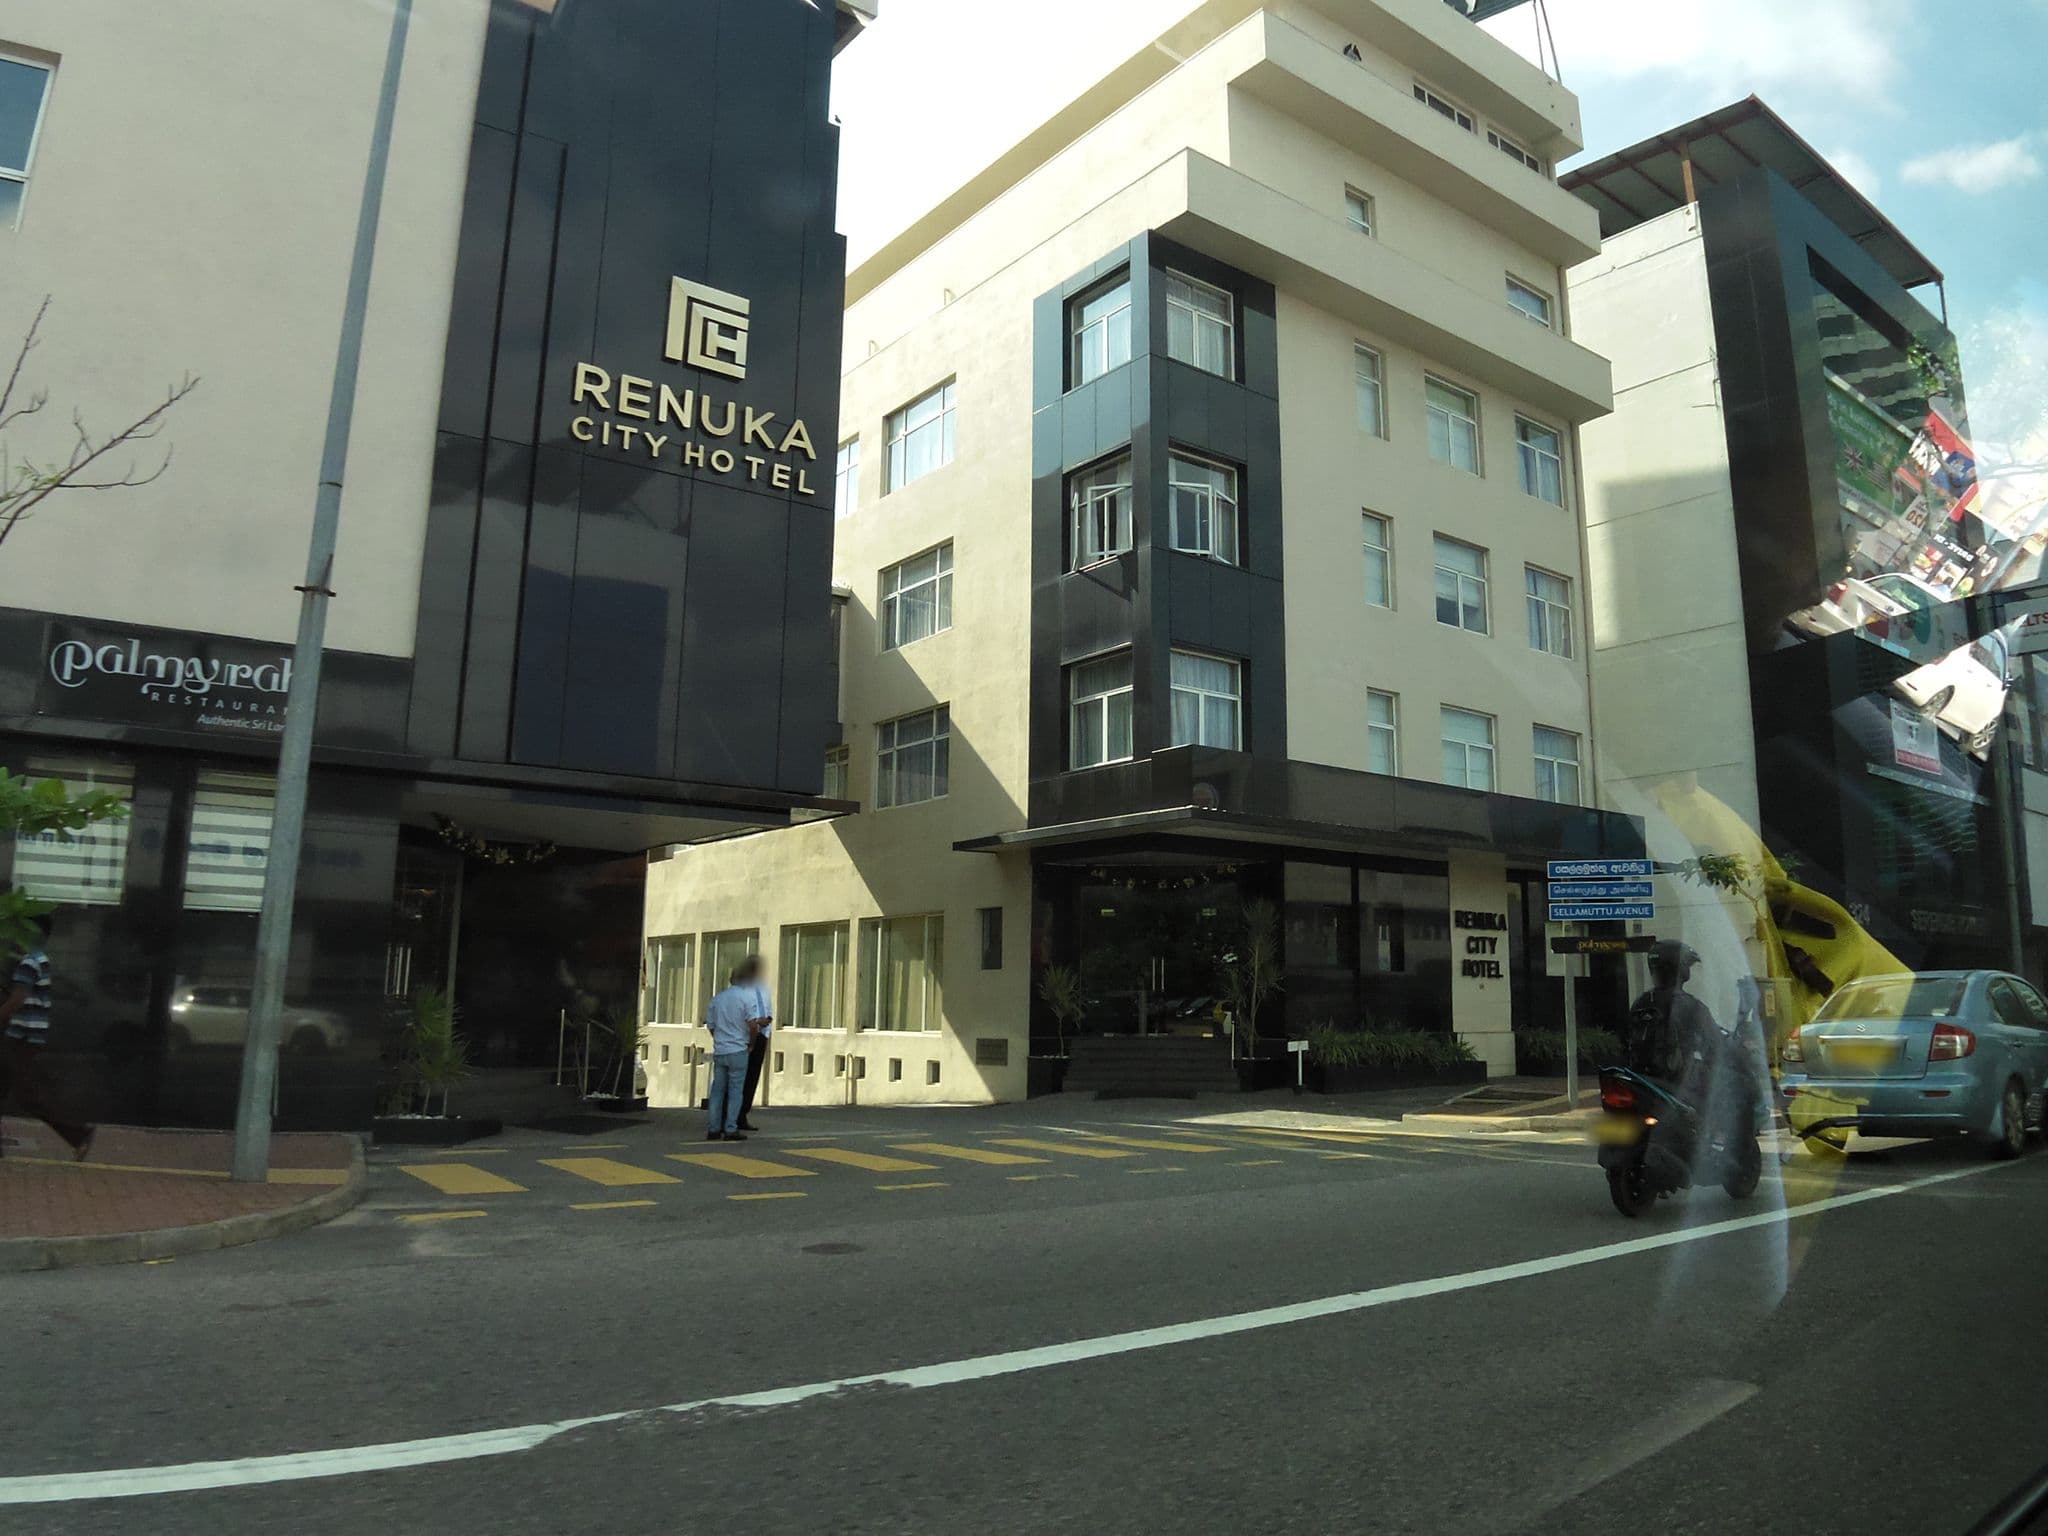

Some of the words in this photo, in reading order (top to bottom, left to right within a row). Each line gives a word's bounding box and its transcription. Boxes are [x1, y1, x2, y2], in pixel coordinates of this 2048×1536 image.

[573, 362, 817, 460] RENUKA
[571, 416, 668, 458] CITY
[684, 441, 815, 495] HOTEL
[151, 691, 288, 715] RESTAURA
[197, 714, 250, 729] Authentic
[1455, 910, 1507, 931] RENUKA
[1554, 906, 1613, 917] SELLAMUTTU
[1614, 906, 1650, 916] AVENUE
[1467, 936, 1498, 954] CITY
[1462, 959, 1504, 978] HOTEL
